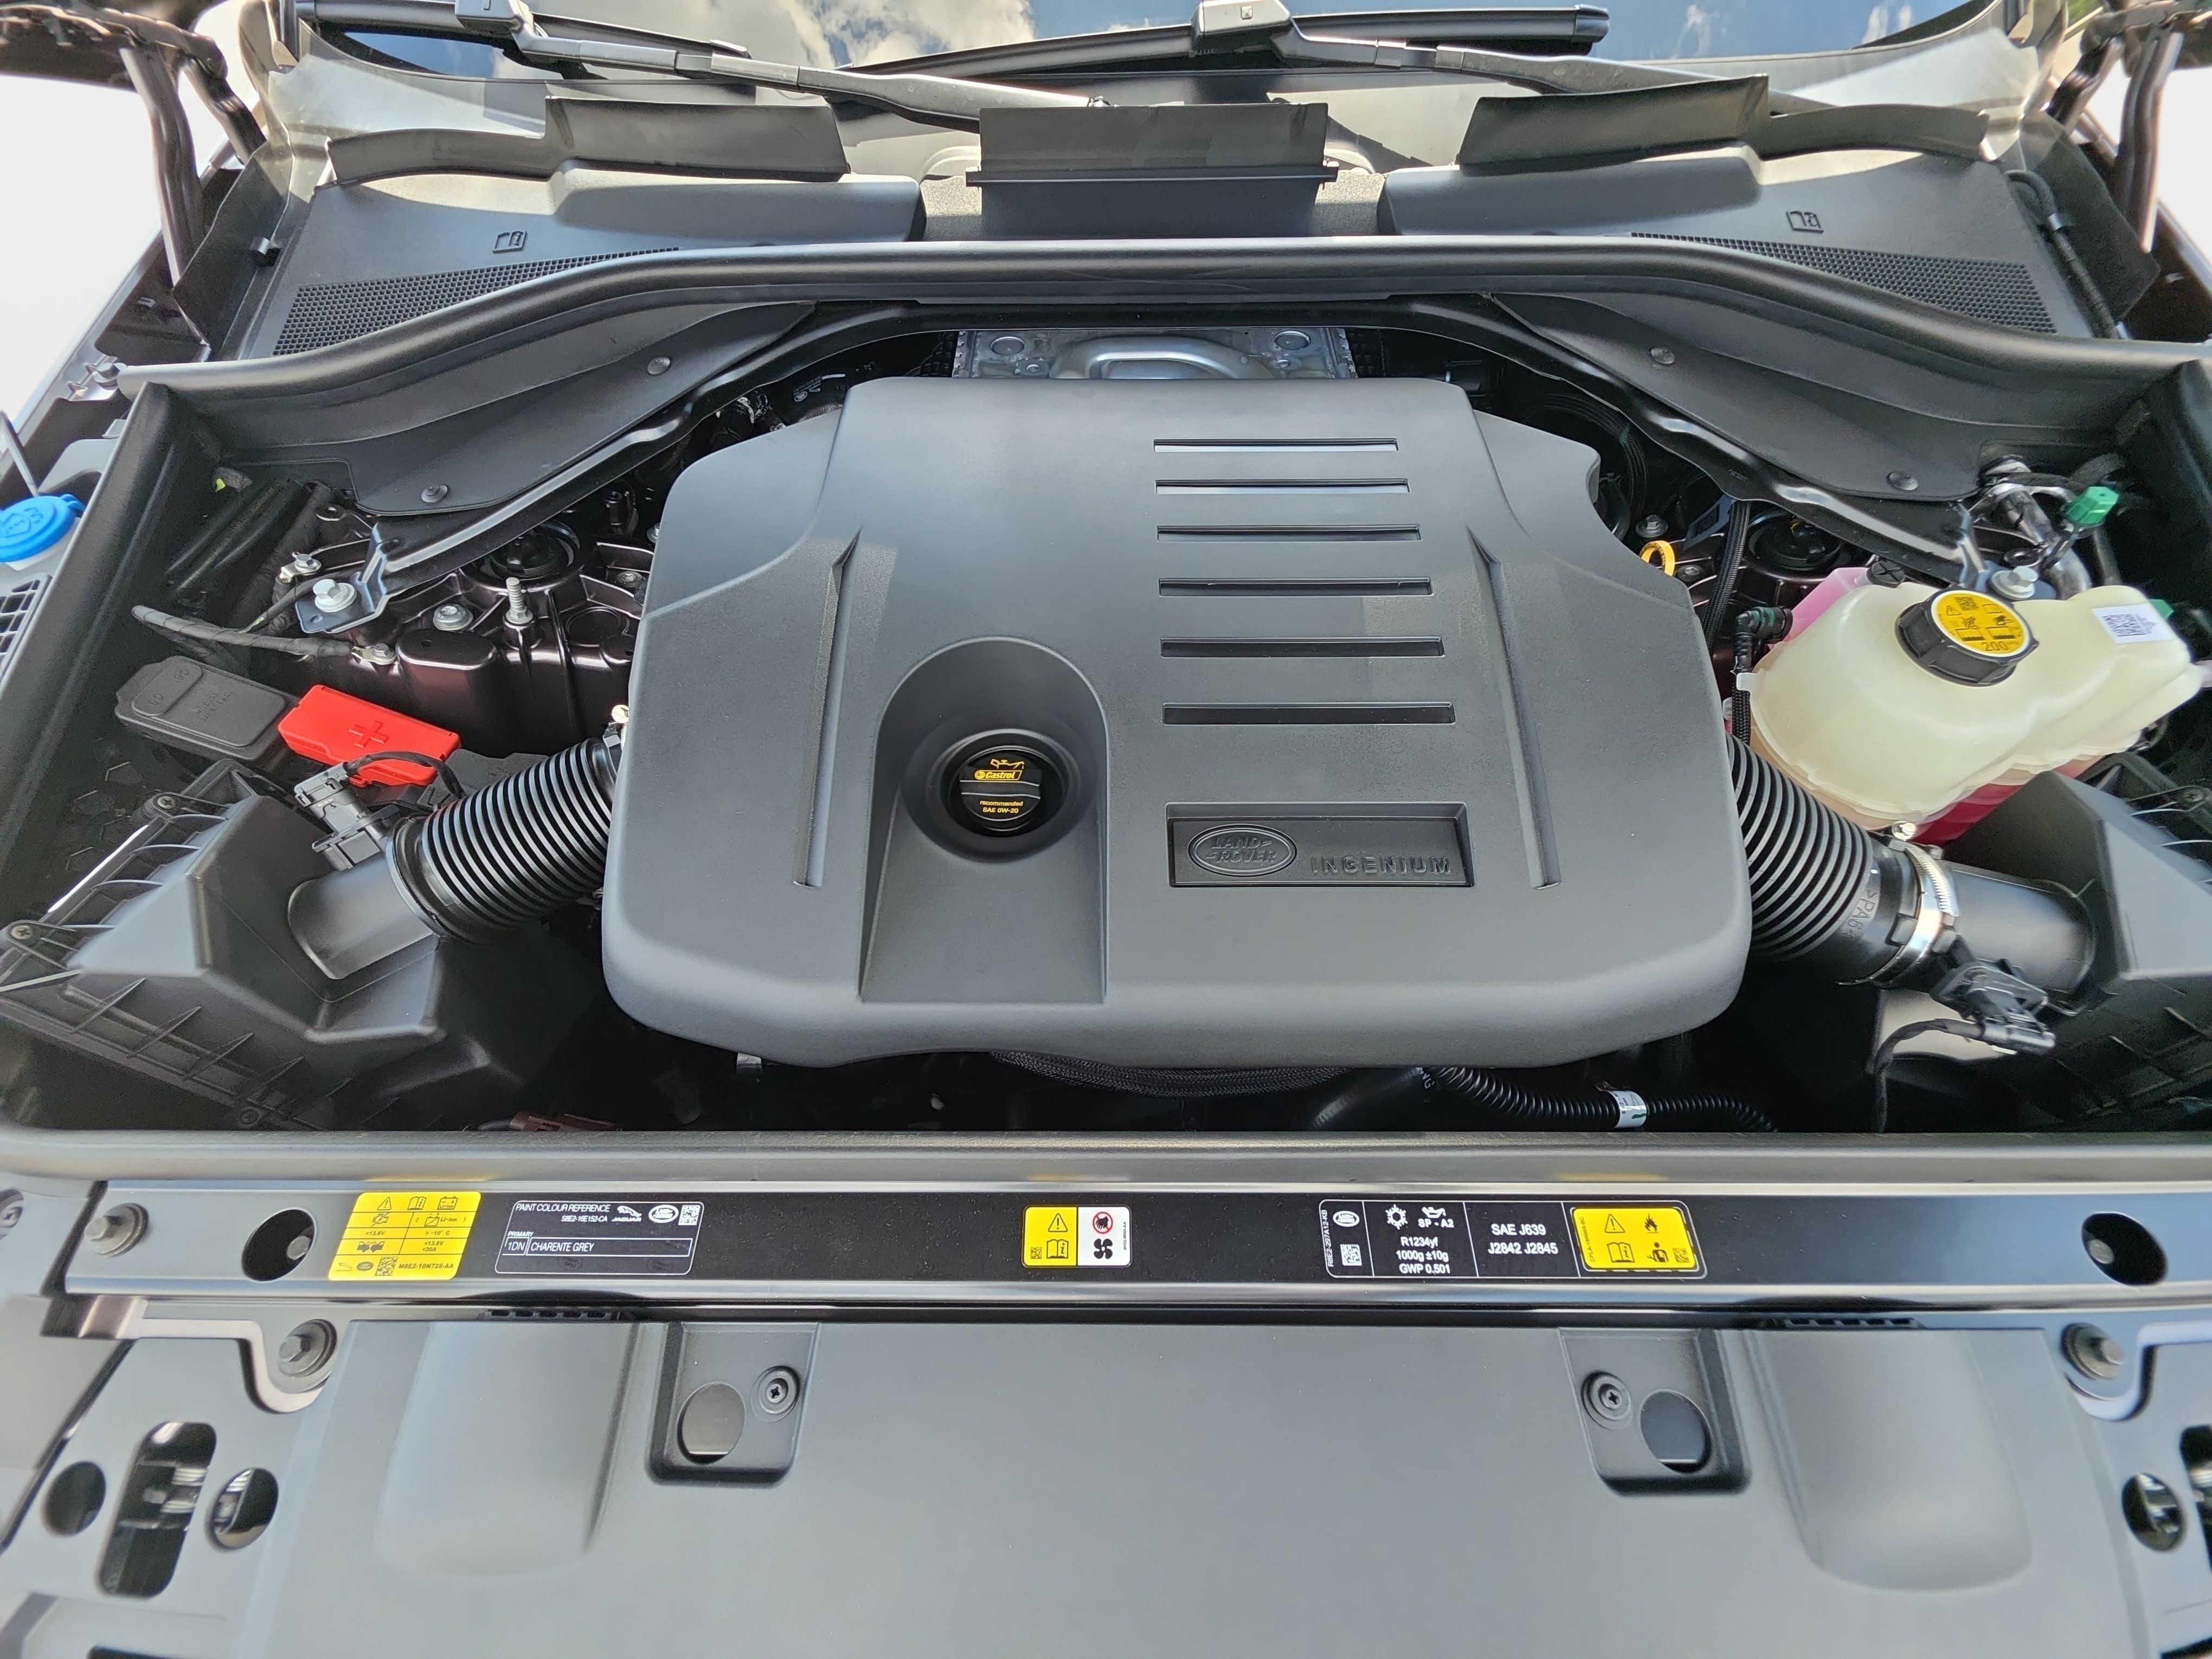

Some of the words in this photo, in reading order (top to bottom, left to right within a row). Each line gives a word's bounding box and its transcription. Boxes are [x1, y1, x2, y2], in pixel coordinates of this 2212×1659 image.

[1212, 837, 1261, 849] LAND
[1217, 850, 1276, 863] ROVER
[1311, 856, 1451, 874] INGENIUM
[516, 1204, 536, 1212] PAINT
[537, 1204, 567, 1212] COLOUR
[568, 1204, 611, 1212] REFERENCE
[1418, 1219, 1431, 1227] SP
[1441, 1219, 1454, 1227] A2
[1491, 1224, 1517, 1236] SAE
[1519, 1224, 1546, 1236] J639
[508, 1242, 525, 1251] 1DN
[531, 1242, 573, 1251] CHARENTE
[573, 1242, 594, 1252] GREY
[1400, 1237, 1438, 1249] R1234yf
[1488, 1242, 1522, 1254] J2842
[1524, 1242, 1558, 1255] J2845
[1396, 1250, 1425, 1262] 1000g
[1426, 1251, 1449, 1262] ±10g
[1399, 1264, 1423, 1274] GWP
[1425, 1264, 1451, 1274] 0.501
